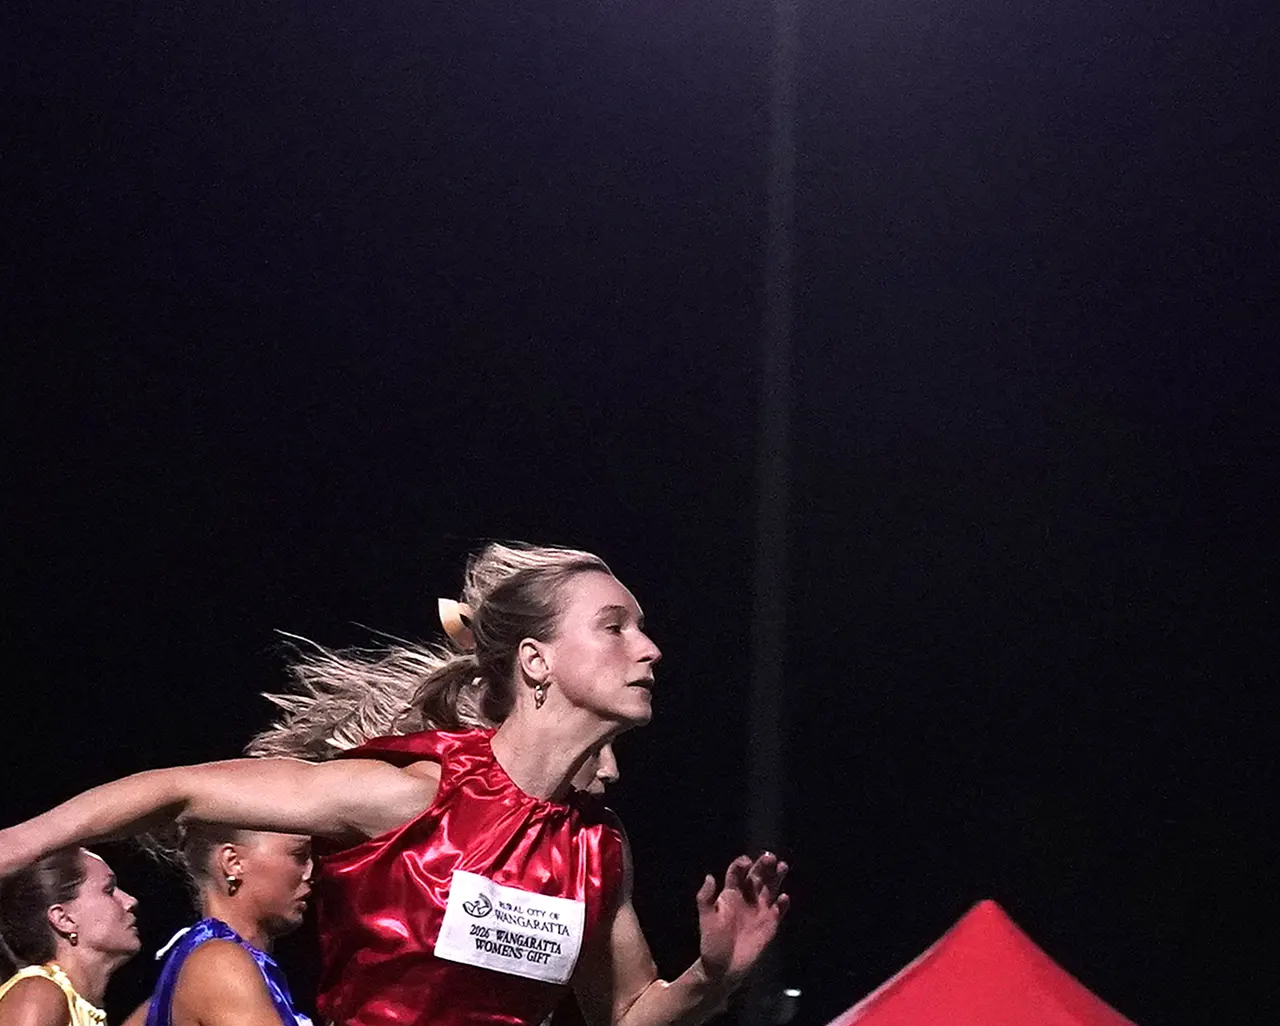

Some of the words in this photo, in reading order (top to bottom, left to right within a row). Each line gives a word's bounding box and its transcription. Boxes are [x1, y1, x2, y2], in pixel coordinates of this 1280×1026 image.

[494, 909, 570, 937] WANGARATTA
[526, 908, 547, 917] CITY
[549, 912, 560, 920] OF
[496, 929, 562, 955] WANGARATTA
[526, 949, 552, 965] GIFT
